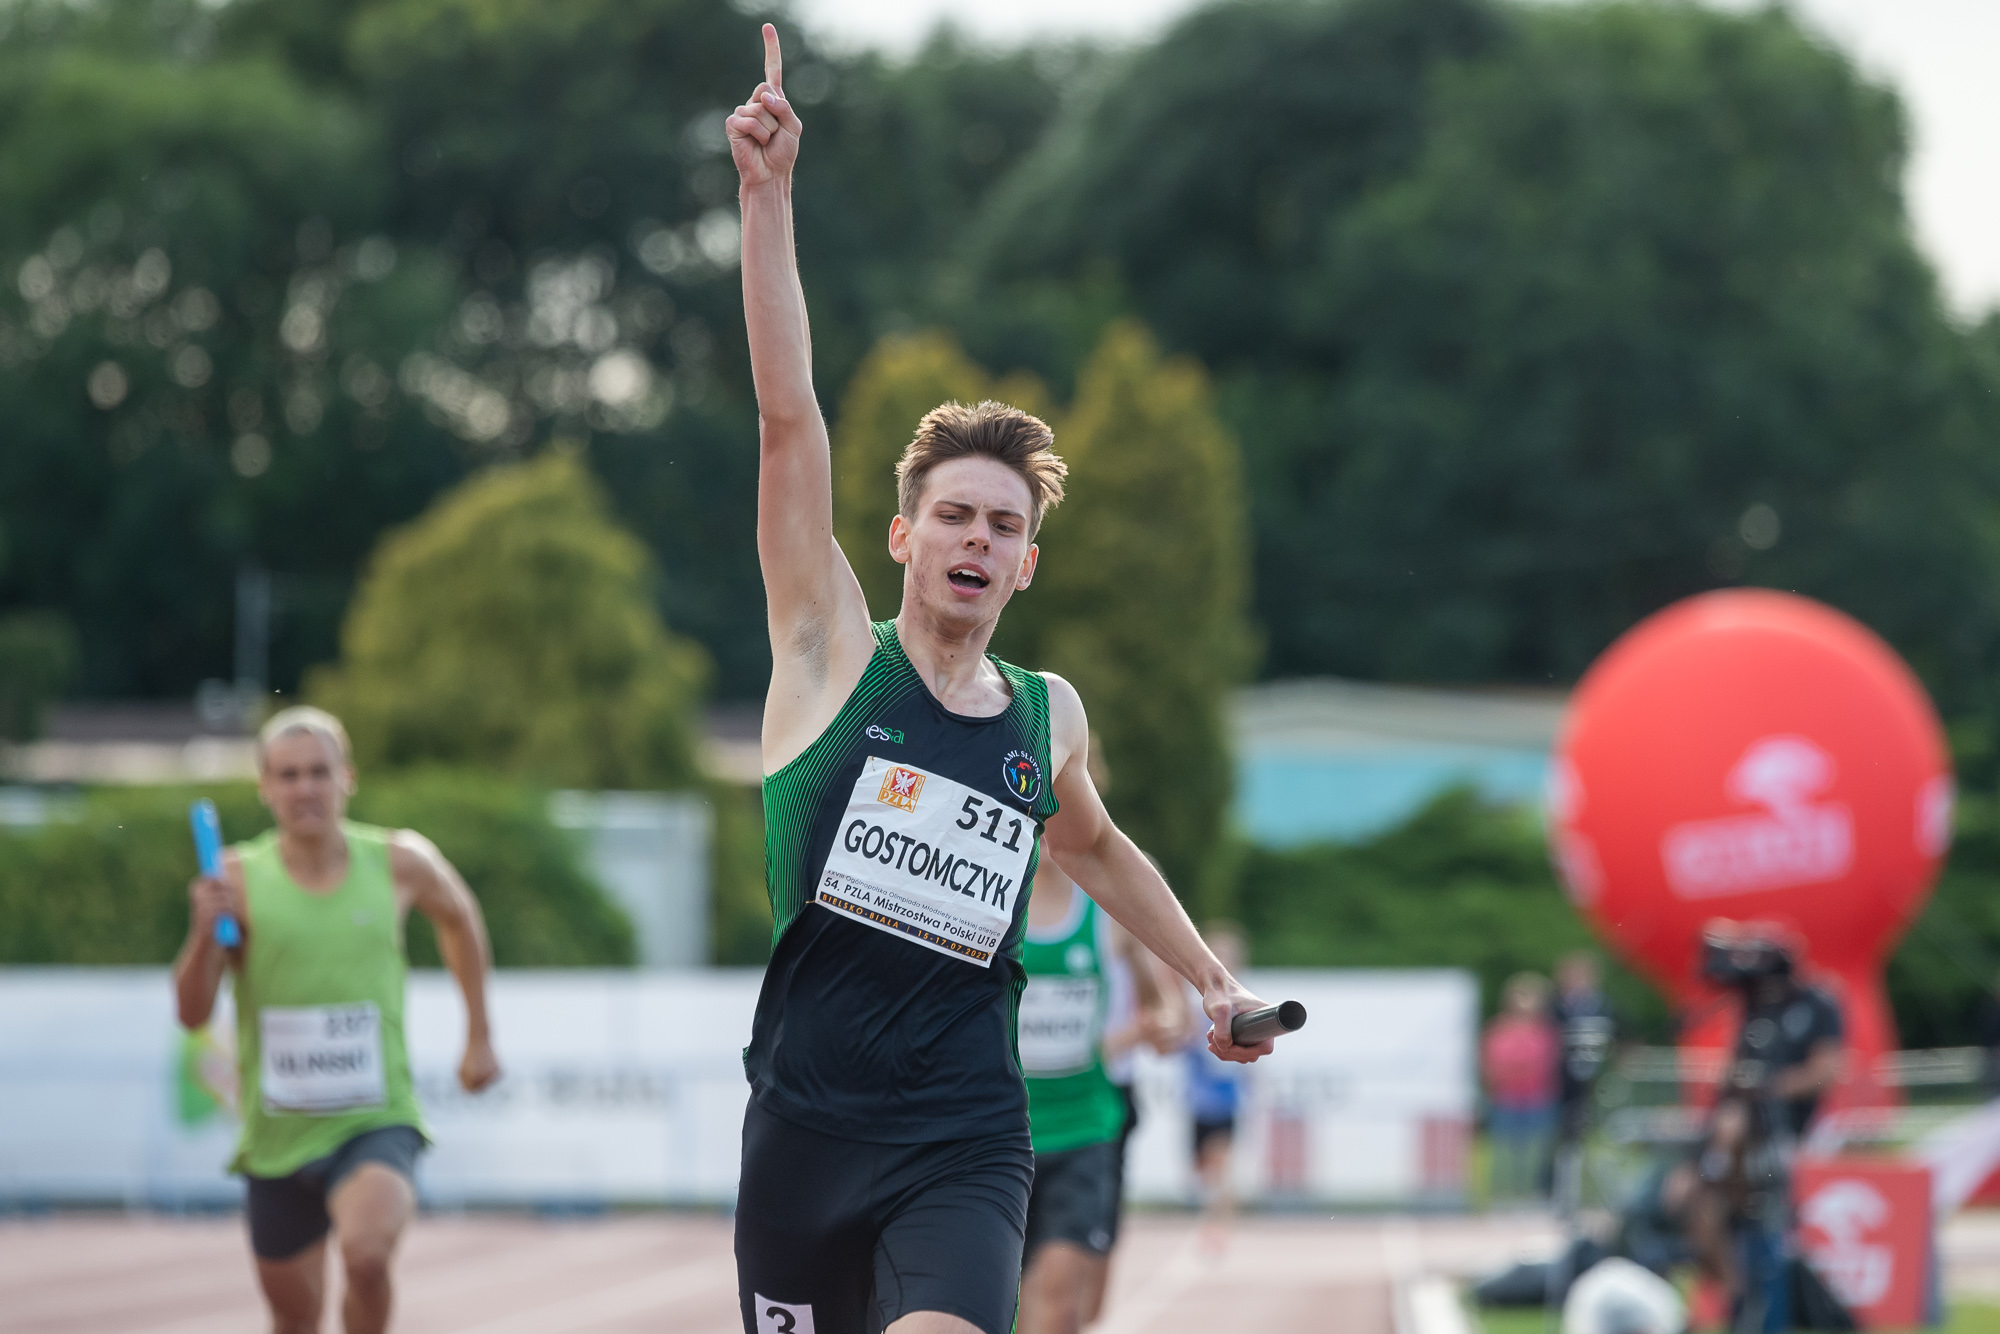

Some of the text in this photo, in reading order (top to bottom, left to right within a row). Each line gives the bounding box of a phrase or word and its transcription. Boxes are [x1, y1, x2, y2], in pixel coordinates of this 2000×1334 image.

[1004, 750, 1020, 764] AML
[880, 790, 913, 811] PZLA
[956, 795, 1023, 853] 511
[844, 819, 1013, 911] GOSTOMCZYK
[824, 877, 997, 948] 54. PZLA Mistrzostwa Polski U18
[846, 875, 888, 895] Ogólnopolska
[889, 891, 920, 907] Olimpiada
[921, 904, 952, 920] Młodzieży
[959, 918, 978, 930] lekkiej
[979, 926, 1001, 937] atletyce
[917, 930, 987, 960] 15-17.07.2022
[766, 1306, 796, 1334] 3
